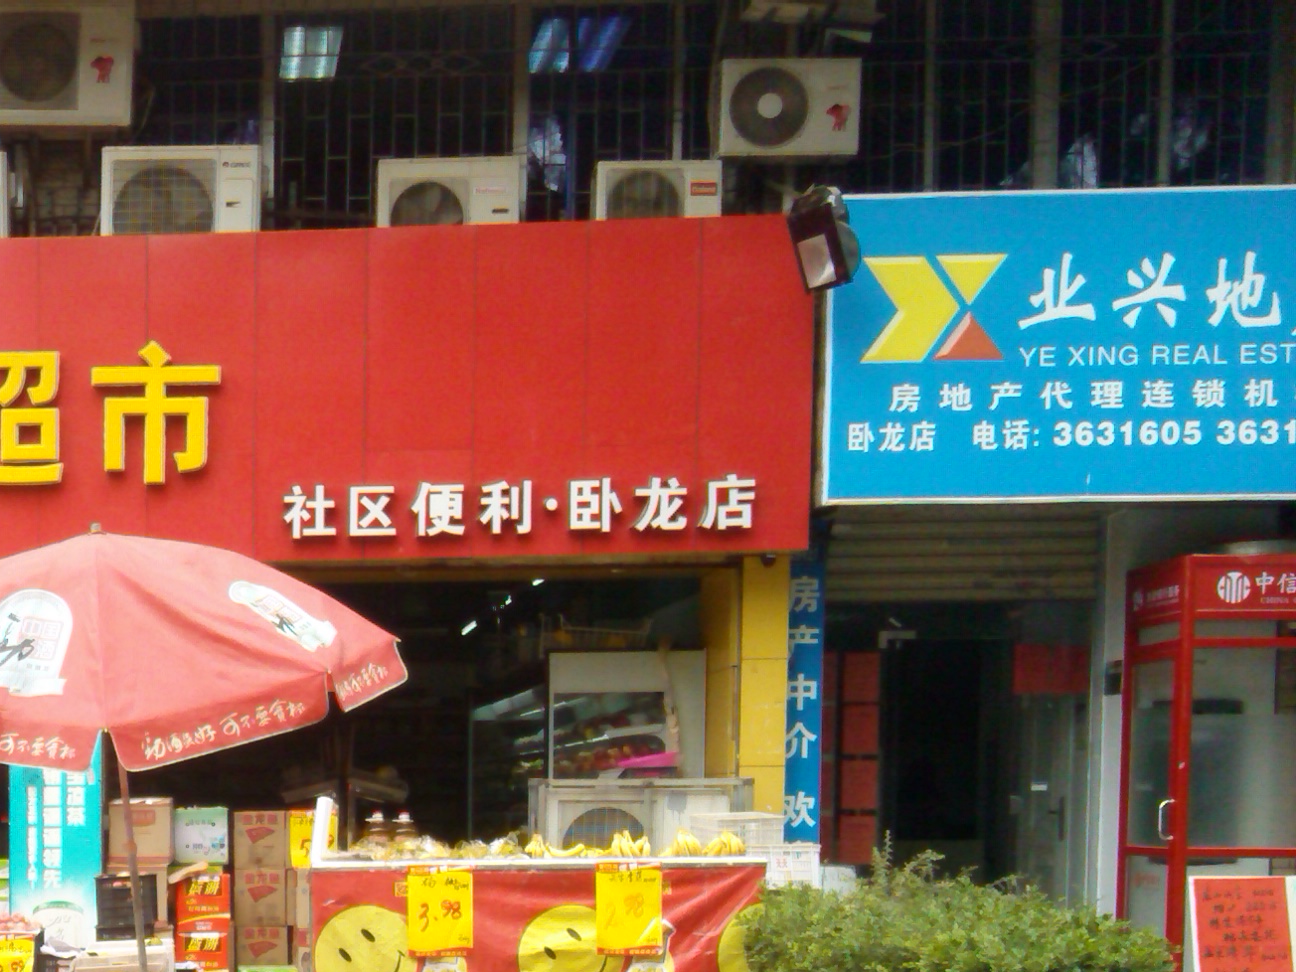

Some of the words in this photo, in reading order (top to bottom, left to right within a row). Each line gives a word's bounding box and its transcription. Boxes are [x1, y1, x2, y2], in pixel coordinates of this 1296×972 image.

[1018, 250, 1296, 337] 业兴地
[1020, 346, 1056, 367] YE
[1068, 344, 1139, 367] XING
[1151, 344, 1227, 366] REAL
[847, 422, 937, 453] 卧龙店
[972, 419, 1041, 450] 电话:
[1053, 419, 1202, 447] 3631605
[1216, 419, 1296, 446] 3631
[283, 473, 757, 541] 社区便利·卧龙店
[787, 575, 821, 759] 房产中介
